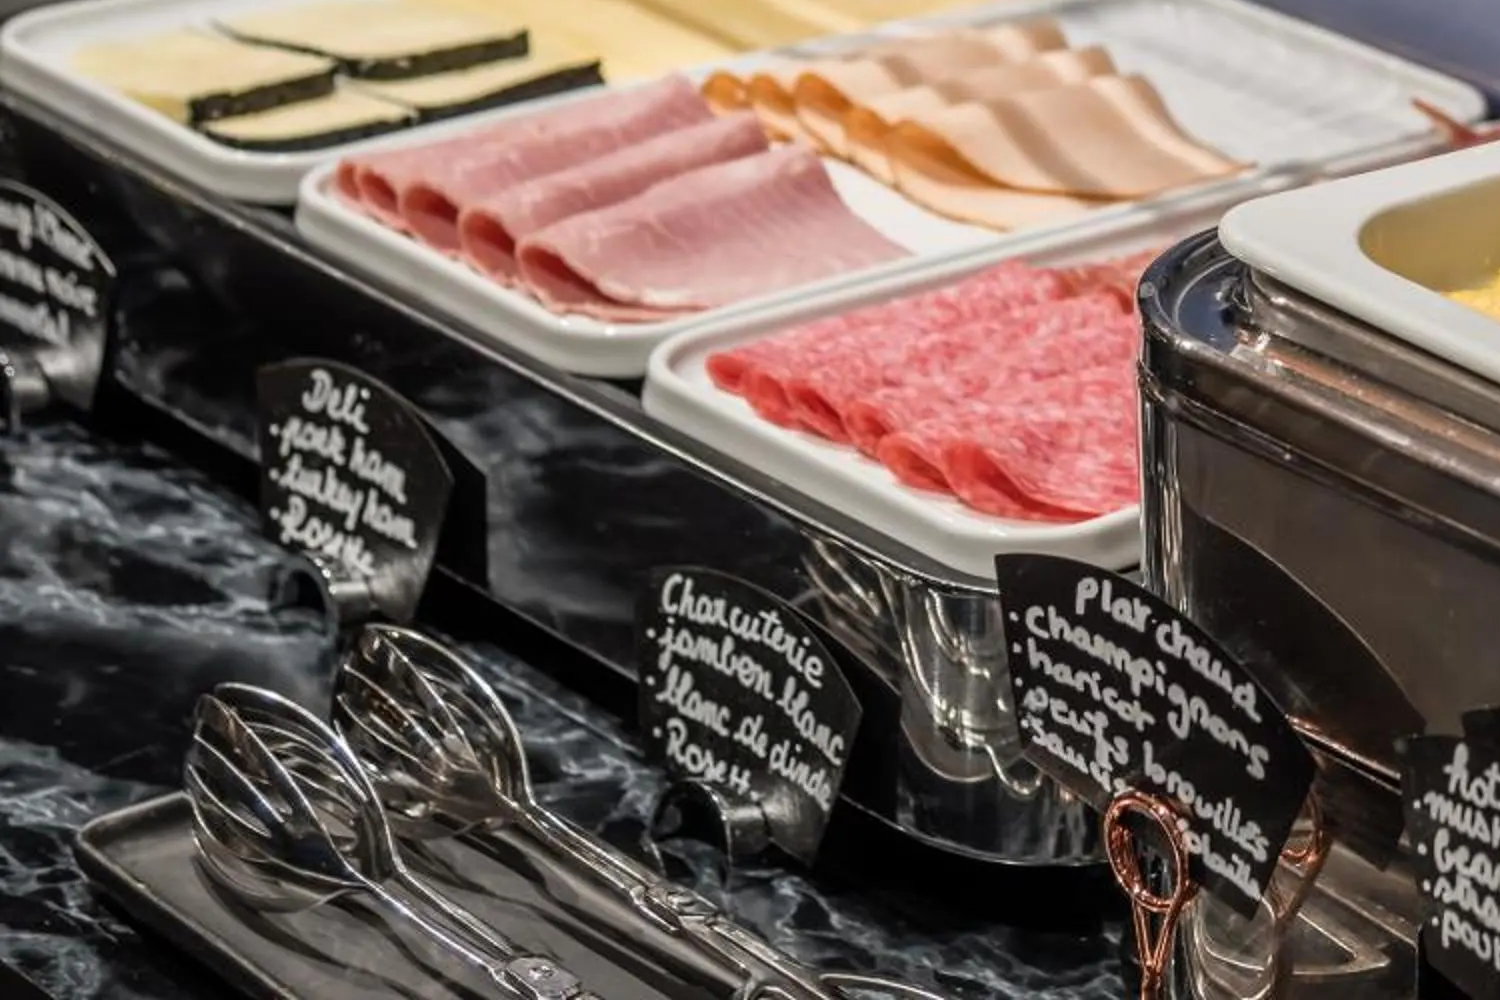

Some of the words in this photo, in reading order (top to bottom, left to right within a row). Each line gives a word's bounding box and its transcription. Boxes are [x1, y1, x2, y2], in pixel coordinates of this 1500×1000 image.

[661, 573, 824, 688] Charcuterie
[1155, 619, 1263, 723] chaud
[657, 617, 775, 700] jambon
[776, 675, 845, 766] blanc
[733, 714, 769, 759] de
[768, 740, 833, 812] dinde
